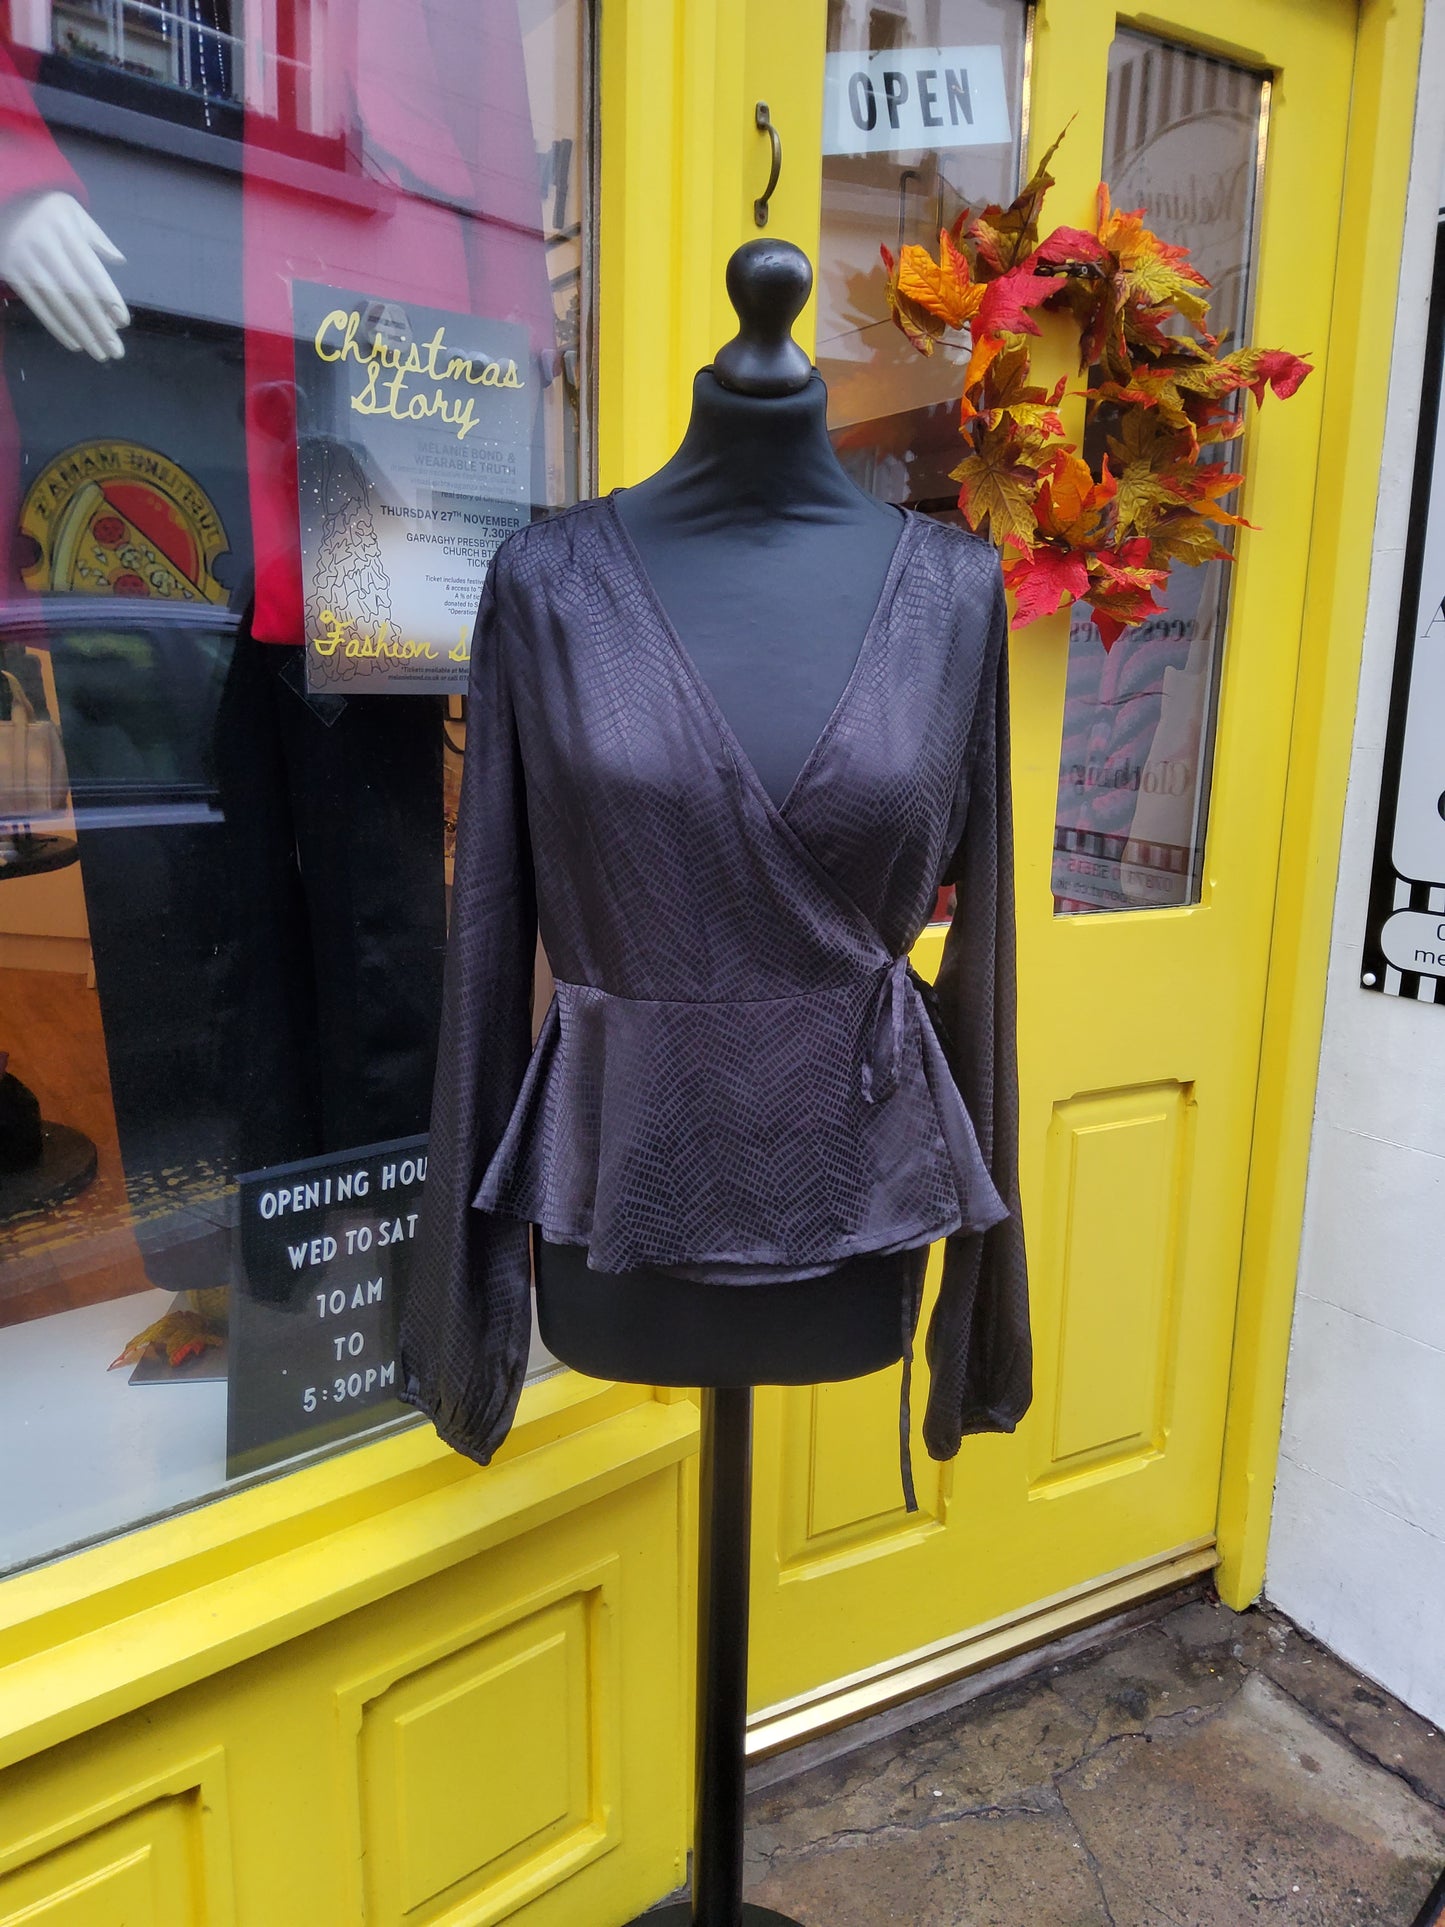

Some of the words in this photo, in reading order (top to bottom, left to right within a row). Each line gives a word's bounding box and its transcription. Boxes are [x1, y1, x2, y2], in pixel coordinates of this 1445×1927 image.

[848, 67, 974, 131] OPEN
[315, 310, 525, 388] Christmas
[351, 361, 480, 440] Story
[414, 455, 477, 472] WEARABLE
[480, 462, 516, 475] TRUTH
[417, 441, 469, 458] MELANIE
[471, 448, 503, 462] BOND
[507, 452, 516, 463] &
[456, 493, 474, 502] story
[380, 505, 438, 521] THURSDAY
[440, 510, 462, 522] 27TH
[463, 513, 520, 528] NOVEMBER
[406, 532, 455, 546] GARVAGHY
[457, 537, 502, 549] PRESBYTE
[482, 527, 516, 539] 7.30P
[443, 546, 480, 558] CHURCH
[425, 575, 442, 583] Ticket
[443, 576, 466, 584] includes
[444, 600, 466, 608] donated
[313, 610, 439, 660] Fashion
[260, 1171, 369, 1220] OPENING
[288, 1236, 337, 1270] WED
[345, 1226, 372, 1255] TO
[377, 1214, 419, 1247] SAT
[316, 1289, 346, 1318] 10
[350, 1277, 383, 1309] AM
[334, 1331, 364, 1361] TO
[303, 1360, 395, 1413] 5:30PM
